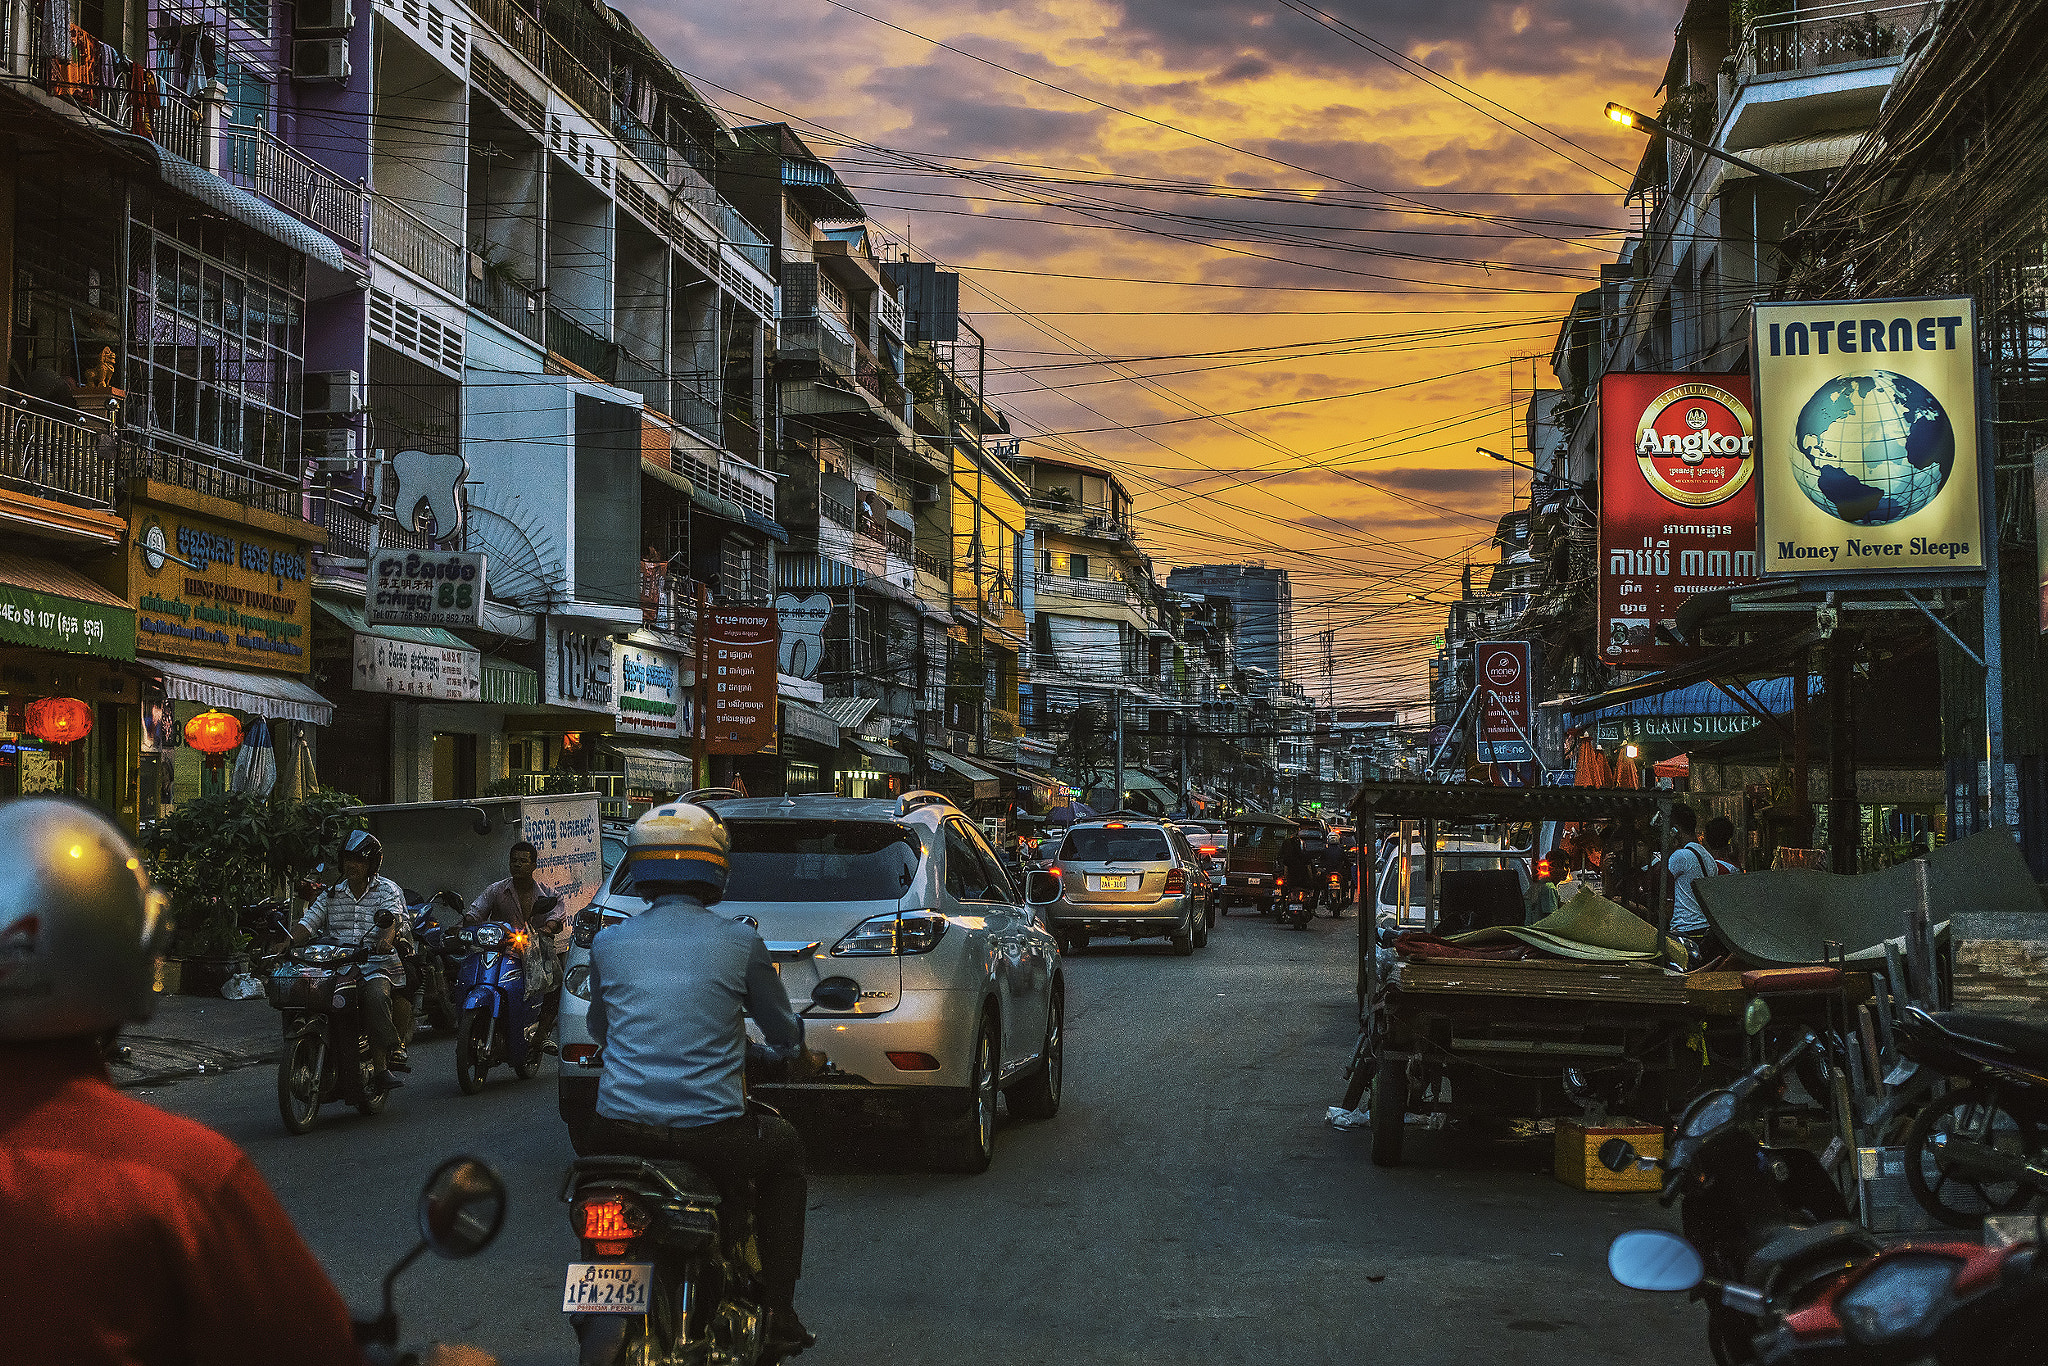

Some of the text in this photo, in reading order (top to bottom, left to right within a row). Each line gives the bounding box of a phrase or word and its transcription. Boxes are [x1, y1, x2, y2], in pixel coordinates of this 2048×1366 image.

[1769, 316, 1963, 357] INTERNET
[1652, 385, 1741, 412] PREMIUM BEER
[1635, 428, 1753, 466] Angkor
[1663, 524, 1732, 538] អាហារដ្ឋាន
[1778, 537, 1970, 562] Money Never Sleeps
[438, 582, 473, 609] 88
[23, 608, 35, 626] St
[37, 611, 55, 629] 107
[385, 610, 398, 619] 077
[432, 613, 444, 622] 012
[1490, 668, 1516, 676] money
[1646, 718, 1689, 735] GIANT
[584, 1266, 632, 1283] ភ្នំពេញ
[576, 1304, 634, 1312] PHNOM PENH
